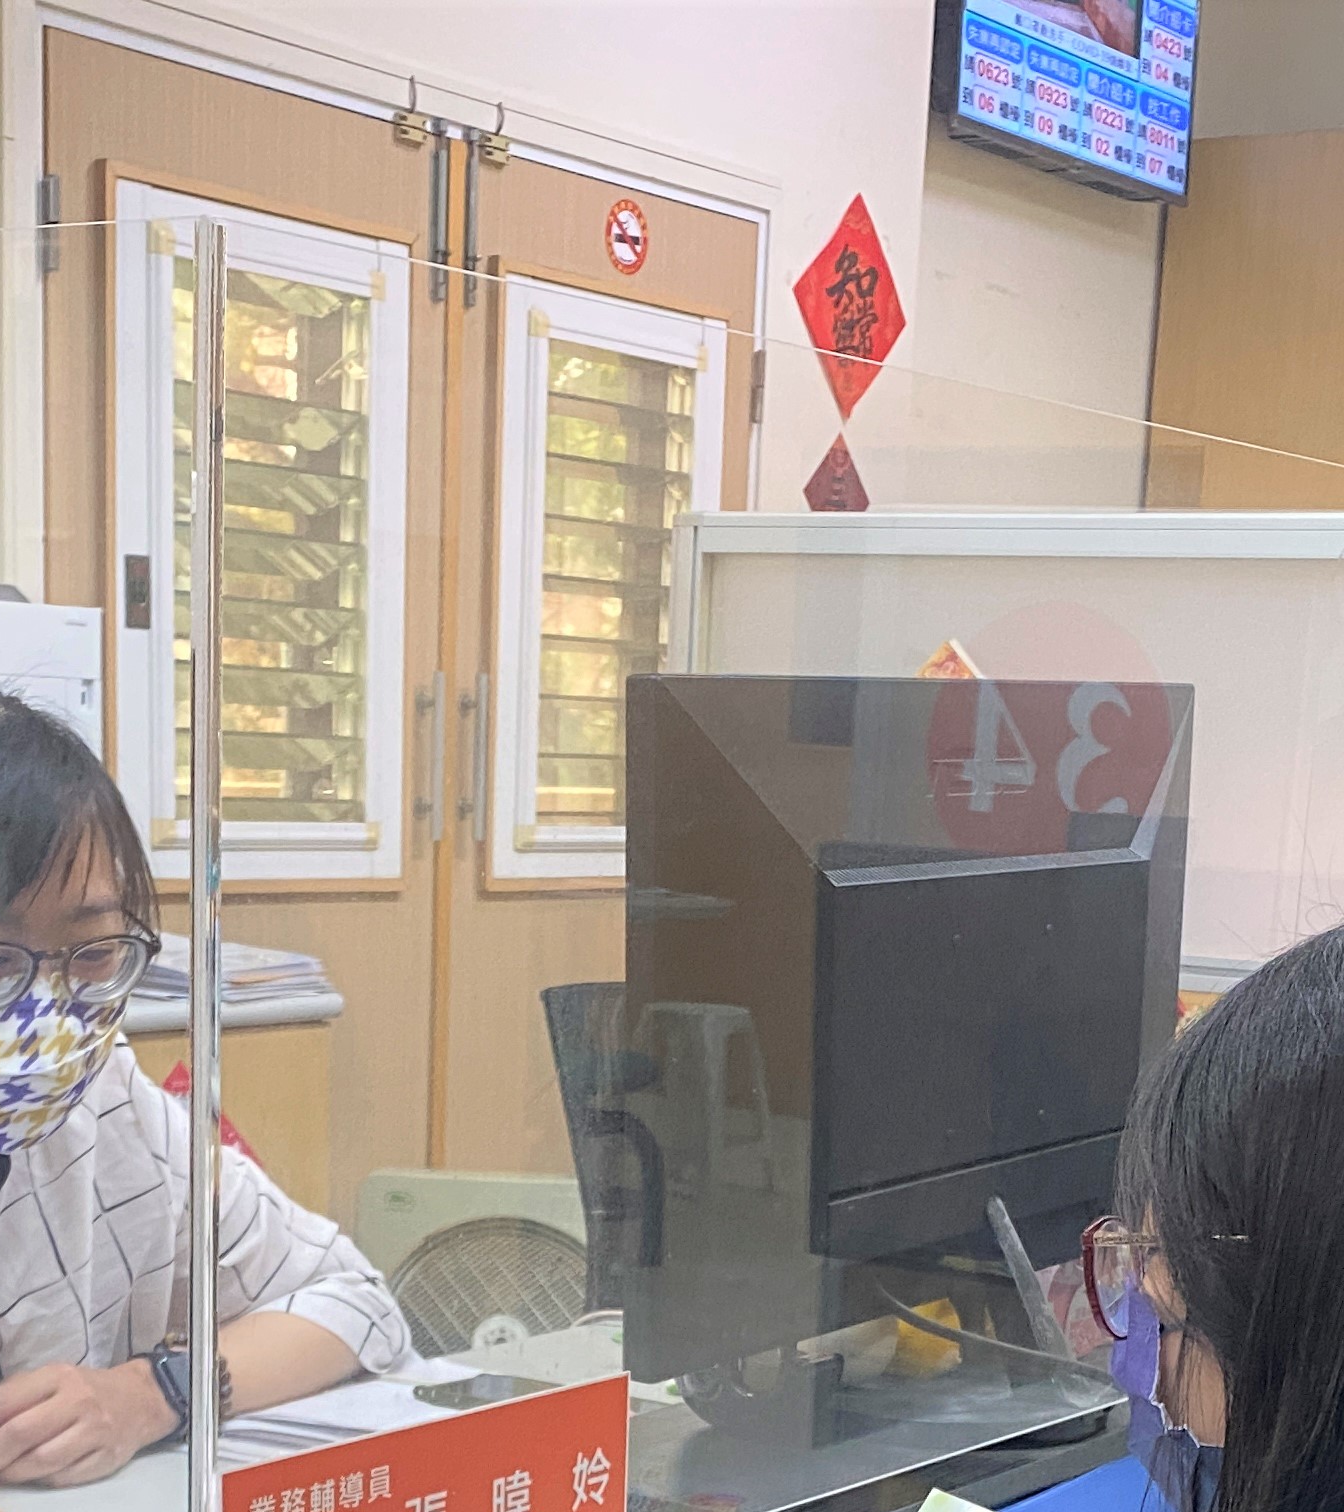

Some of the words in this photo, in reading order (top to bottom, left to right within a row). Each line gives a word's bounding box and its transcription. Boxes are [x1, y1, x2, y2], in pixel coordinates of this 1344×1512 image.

[978, 59, 1009, 86] 0623
[978, 93, 994, 113] 06
[1038, 84, 1067, 109] 0923
[1038, 116, 1053, 136] 09
[1096, 105, 1123, 130] 0223
[1096, 137, 1109, 156] 02
[1149, 157, 1163, 175] 07
